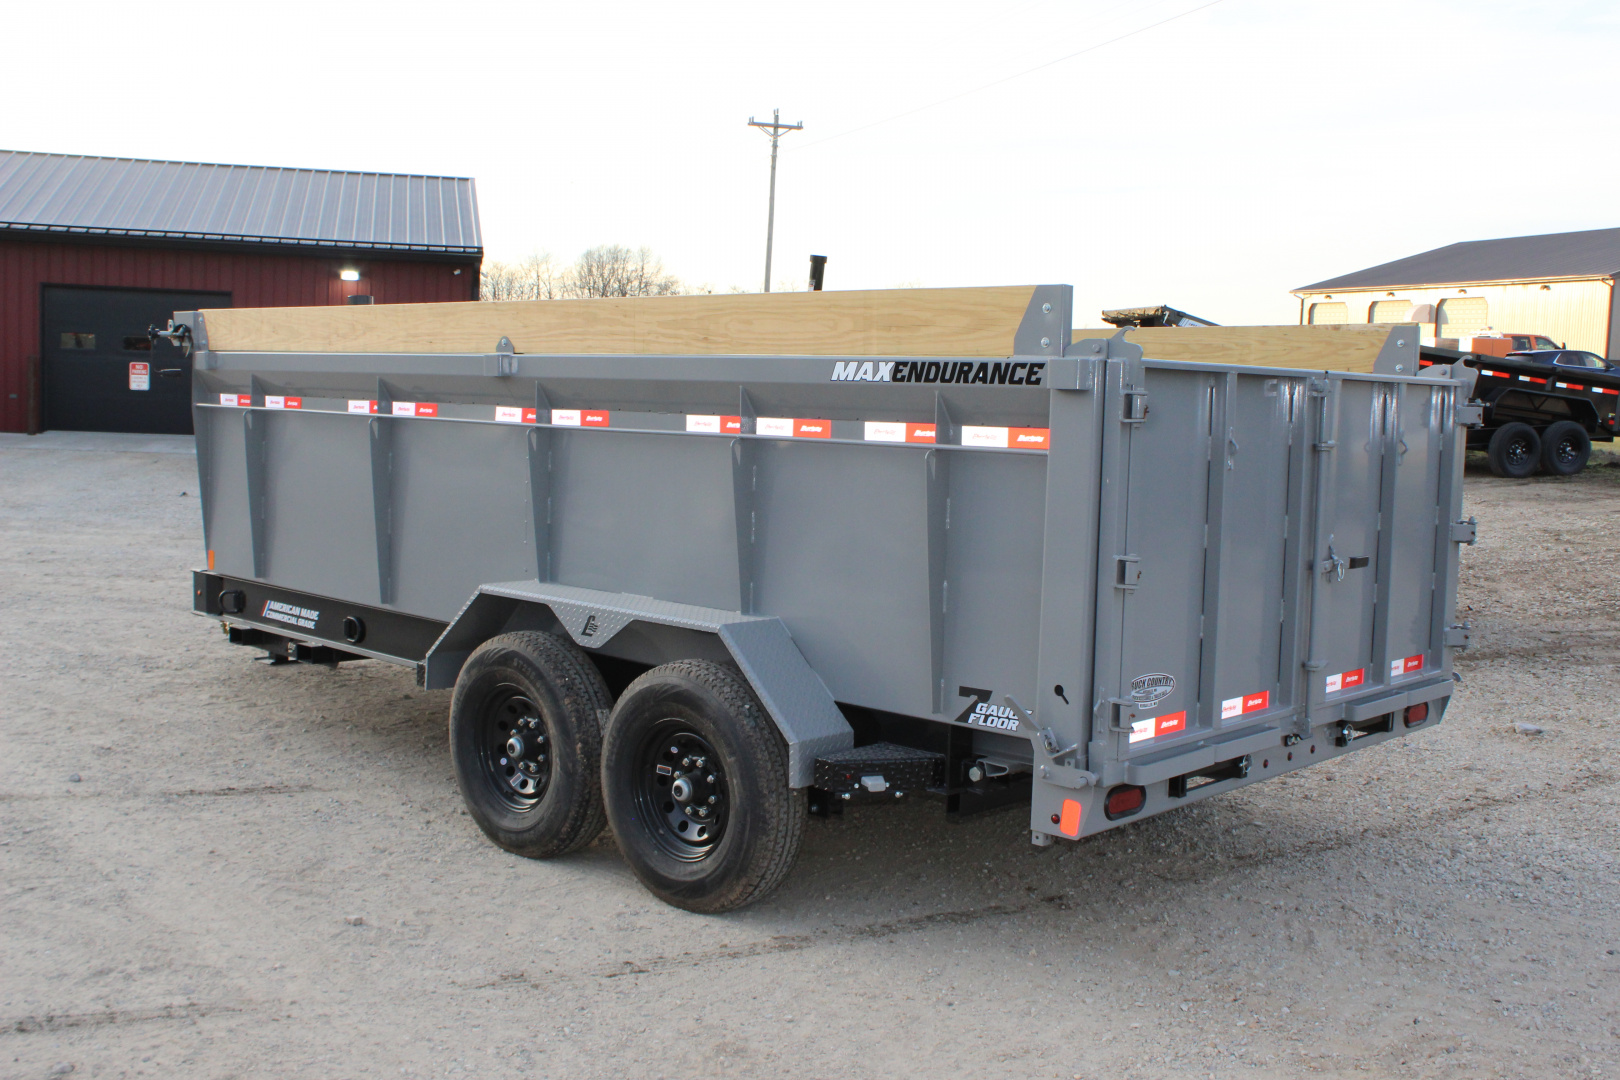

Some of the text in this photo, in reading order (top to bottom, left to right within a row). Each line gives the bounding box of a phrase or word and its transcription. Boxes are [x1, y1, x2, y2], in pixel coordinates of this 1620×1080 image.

[266, 610, 298, 625] COMMERCIAL
[269, 601, 319, 620] AMERICAN MADE
[954, 685, 993, 724] 7
[975, 702, 1033, 720] GAU
[968, 712, 1020, 731] FLOOR
